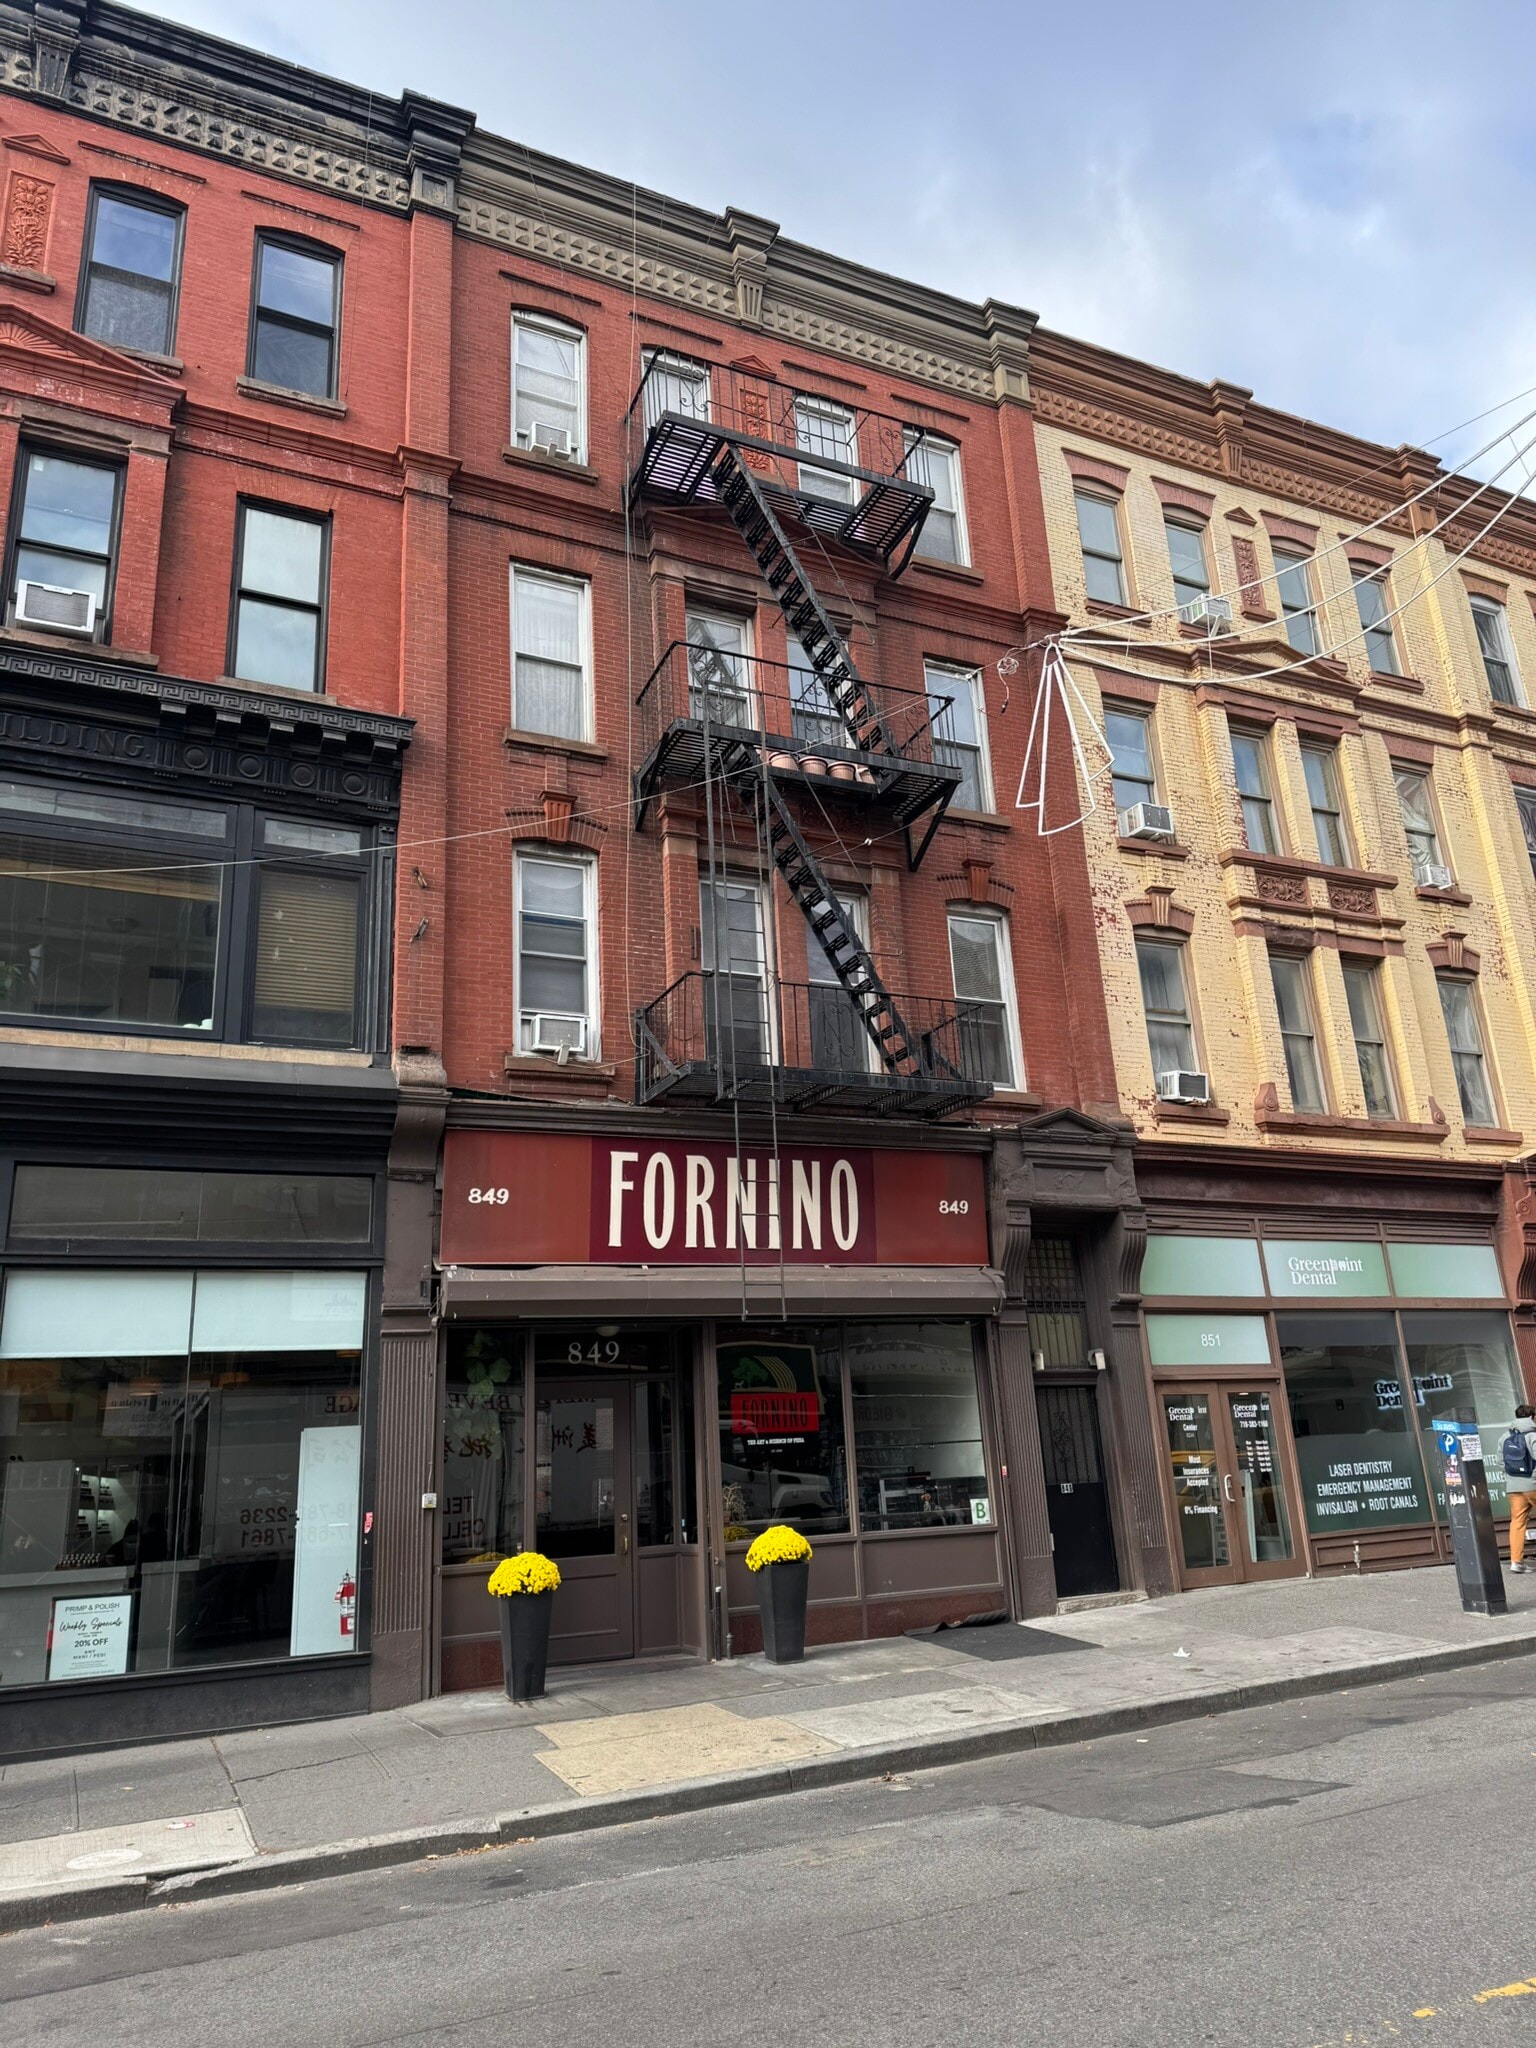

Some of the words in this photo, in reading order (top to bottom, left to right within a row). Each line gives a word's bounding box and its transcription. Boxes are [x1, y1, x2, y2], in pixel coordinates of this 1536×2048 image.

[0, 712, 150, 758] ILDING.
[468, 1187, 509, 1206] 849
[608, 1150, 860, 1251] FORNINO
[939, 1199, 969, 1215] 849
[1288, 1256, 1363, 1273] Greenpoint
[1291, 1270, 1337, 1285] Dental
[1201, 1333, 1221, 1347] 851
[567, 1341, 620, 1364] 849
[741, 1398, 808, 1429] FORNINO
[1328, 1463, 1353, 1477] LASER
[1353, 1460, 1393, 1476] DENTISTRY
[1485, 1471, 1507, 1484] MAKE
[1317, 1481, 1361, 1496] EMERGENCY
[1363, 1477, 1412, 1493] MANAGEMENT
[976, 1502, 986, 1518] B
[1316, 1500, 1359, 1516] INVISALIGN
[1369, 1497, 1389, 1511] ROOT
[1390, 1495, 1418, 1509] CANALS
[94, 1602, 120, 1610] POLISH
[60, 1620, 87, 1632] Weekly
[91, 1617, 123, 1631] Specials
[74, 1640, 91, 1648] 20%
[92, 1638, 108, 1646] OFF
